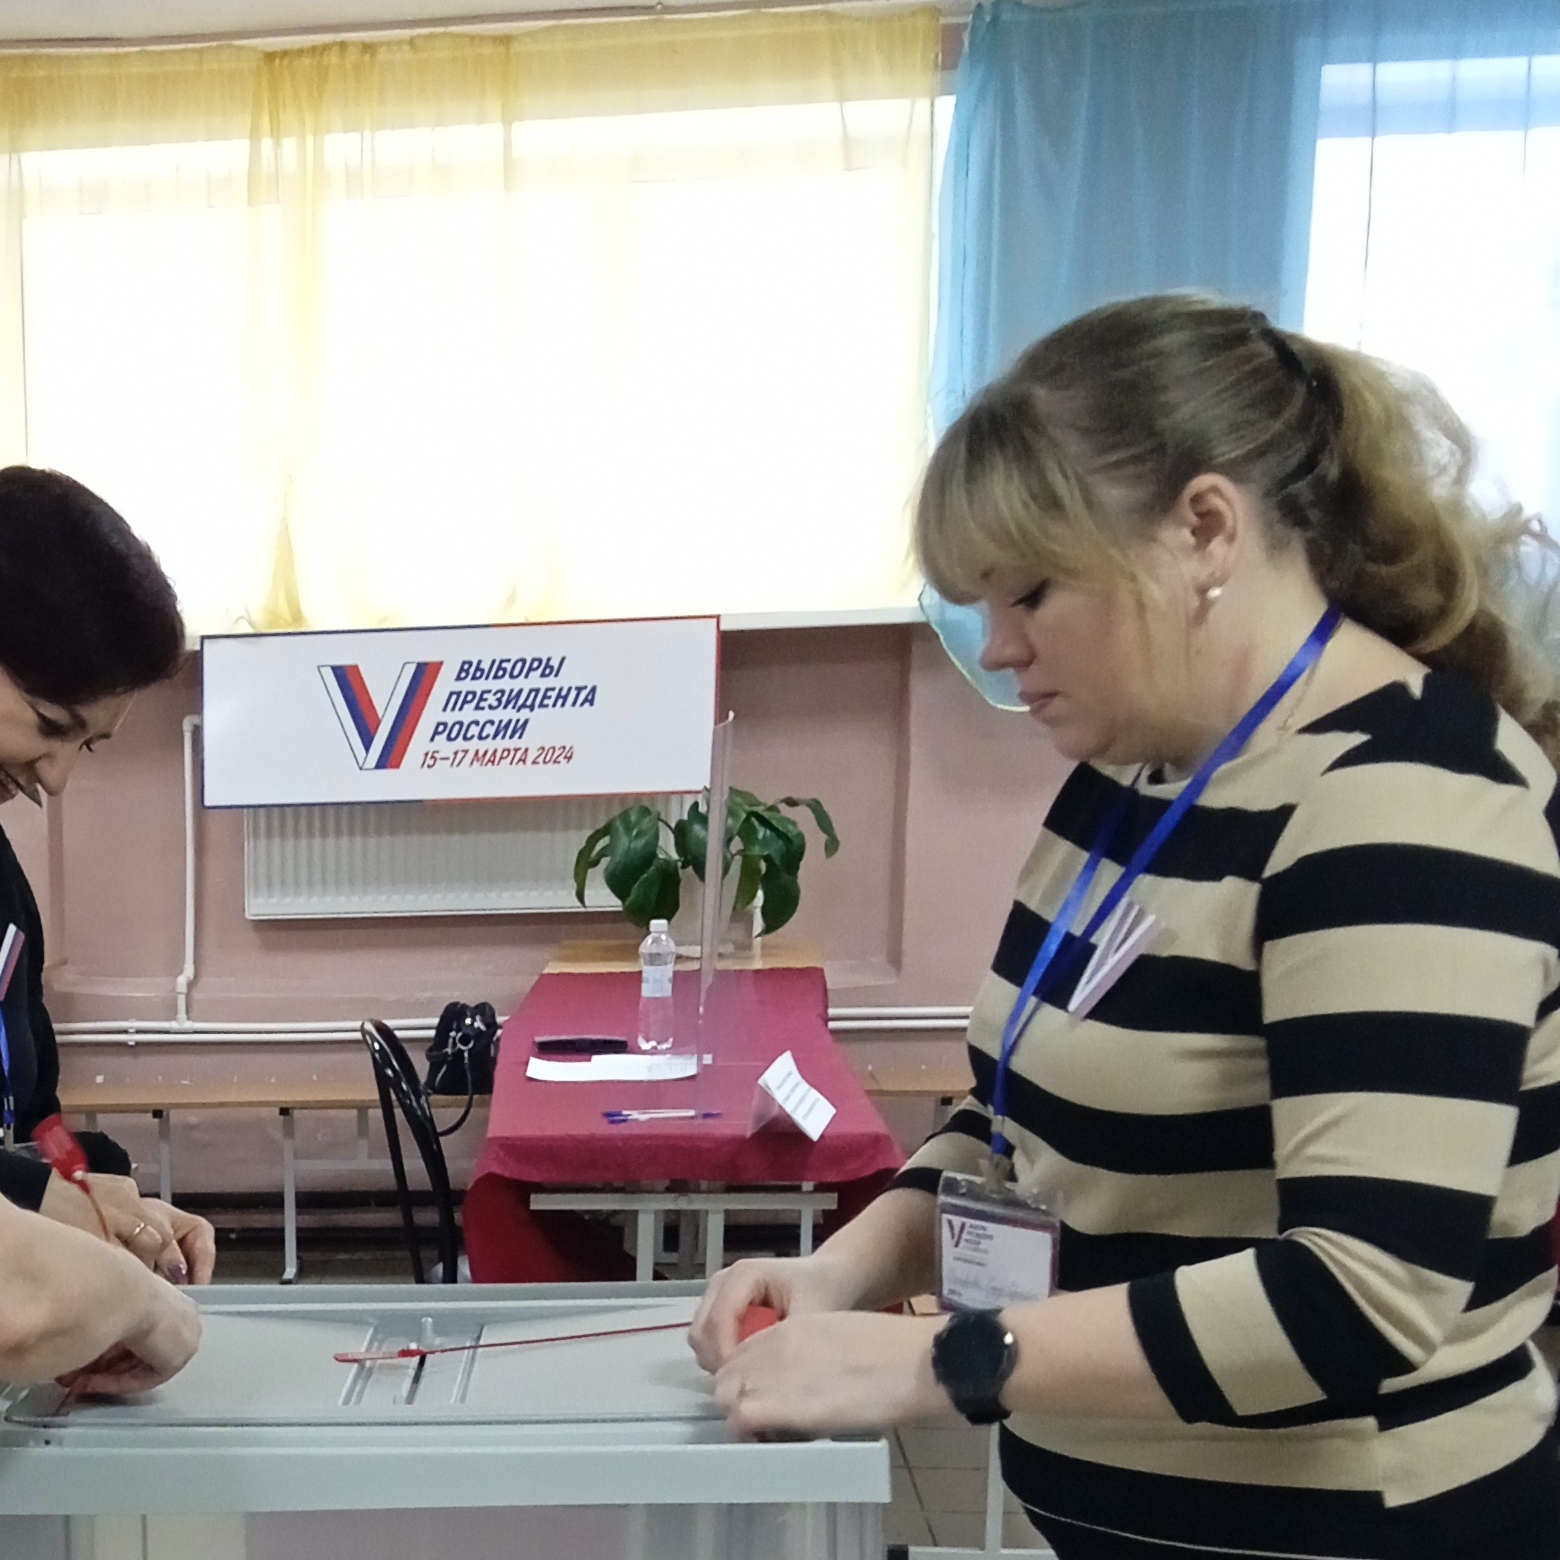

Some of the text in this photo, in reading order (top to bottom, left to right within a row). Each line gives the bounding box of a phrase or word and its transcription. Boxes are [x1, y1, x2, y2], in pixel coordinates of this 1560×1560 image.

[454, 656, 567, 682] ВЫБОРЫ
[442, 685, 598, 713] ПРЕЗИДЕНТА
[429, 718, 530, 743] РОССИИ
[469, 747, 530, 768] МАРТА
[531, 745, 575, 766] 2024
